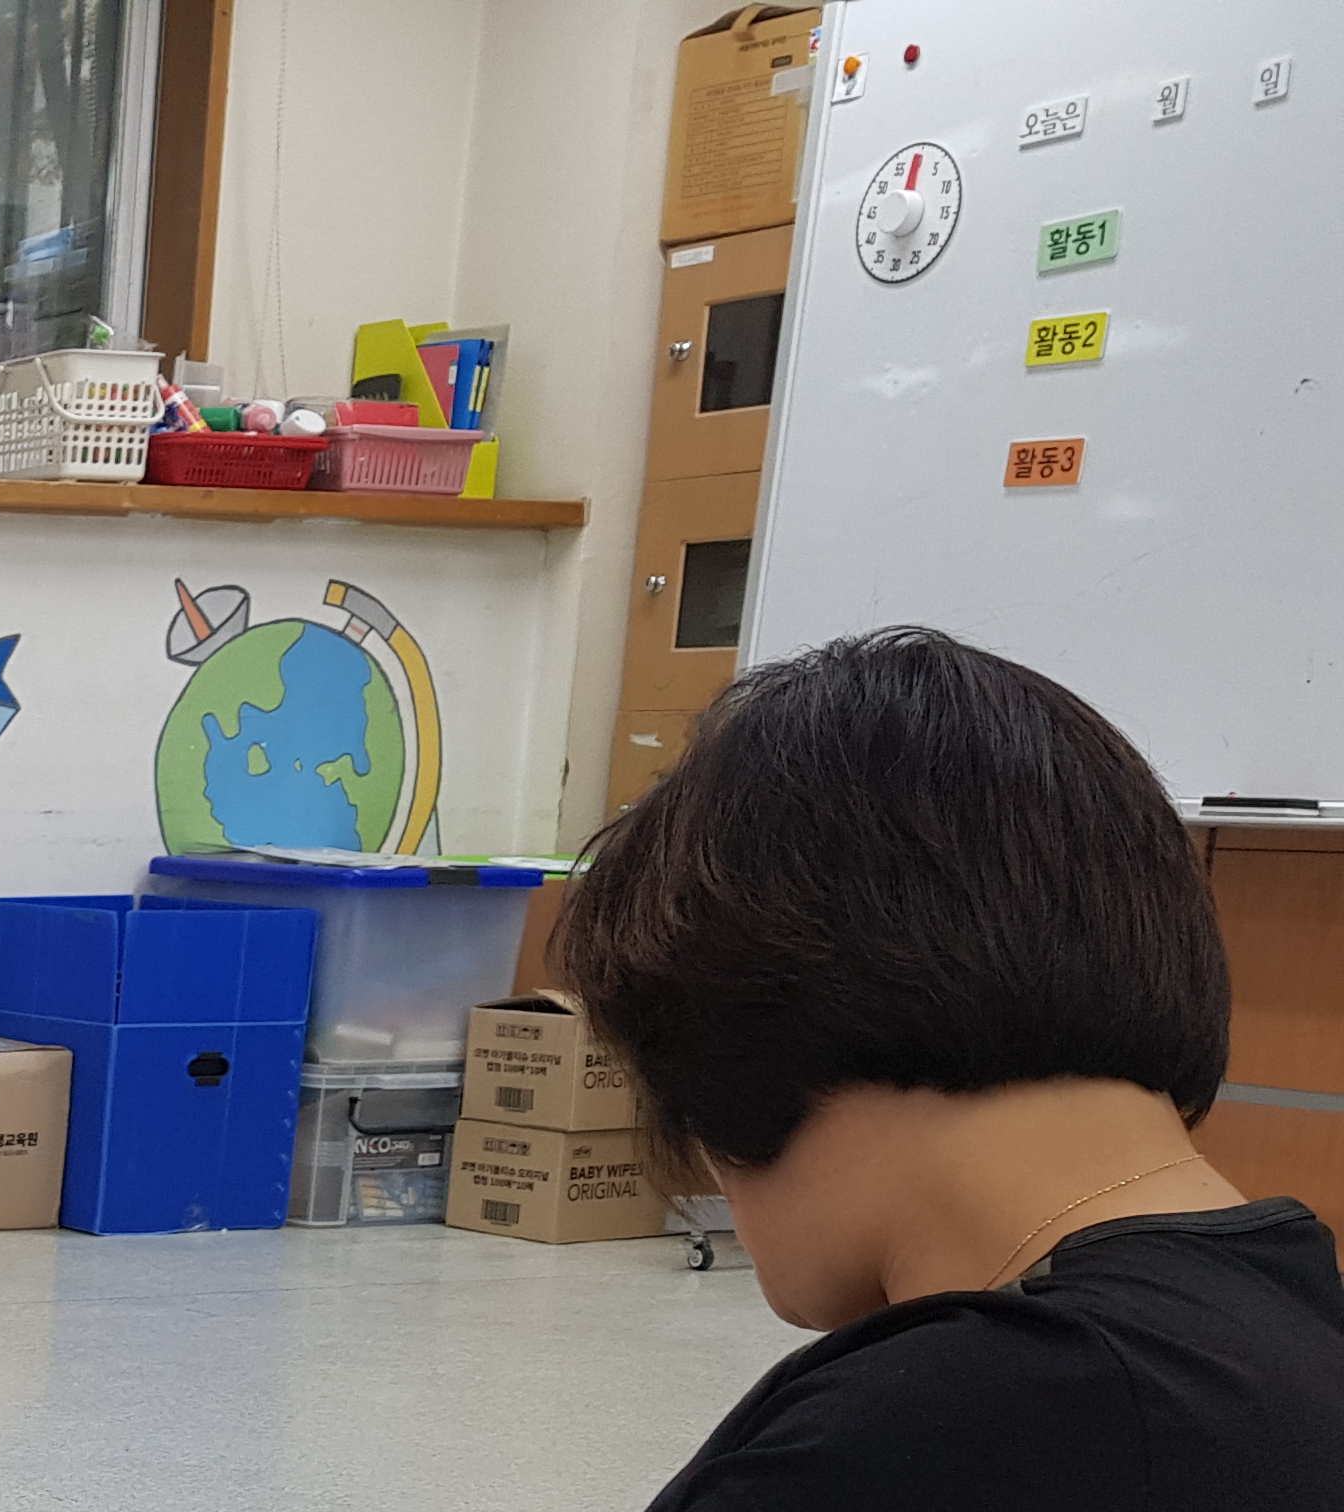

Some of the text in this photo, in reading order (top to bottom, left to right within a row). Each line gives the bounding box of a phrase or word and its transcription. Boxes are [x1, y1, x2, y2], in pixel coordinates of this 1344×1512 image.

[1021, 62, 1281, 140] 오늘은 월 일
[894, 162, 906, 176] 55
[932, 162, 940, 176] 5
[877, 181, 888, 195] 50
[941, 180, 952, 194] 10
[867, 206, 878, 220] 45
[940, 206, 952, 220] 15
[865, 232, 876, 245] 40
[927, 232, 940, 246] 20
[1046, 220, 1110, 262] 활동1
[874, 250, 886, 264] 35
[910, 250, 921, 264] 25
[890, 258, 901, 272] 30
[1033, 320, 1099, 358] 활동2
[1013, 445, 1076, 480] 활동3
[569, 1165, 603, 1181] BABY
[567, 1180, 640, 1202] ORIGINAL
